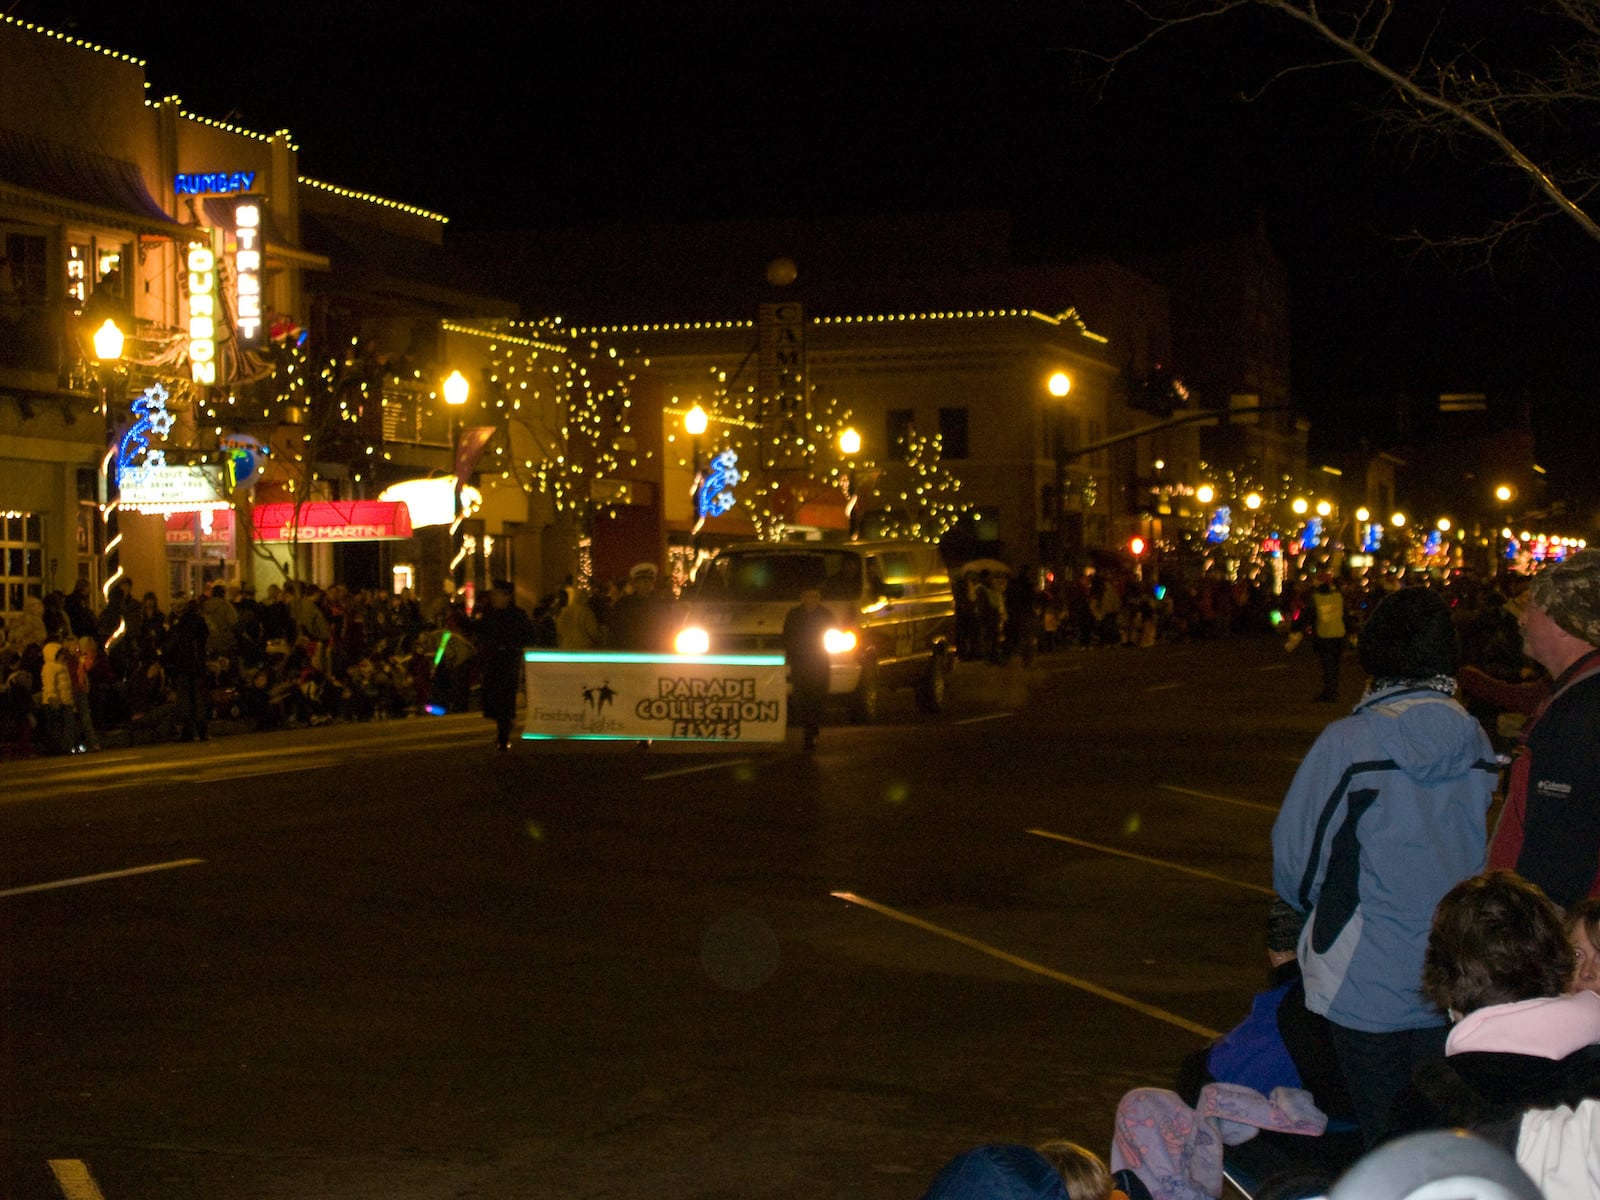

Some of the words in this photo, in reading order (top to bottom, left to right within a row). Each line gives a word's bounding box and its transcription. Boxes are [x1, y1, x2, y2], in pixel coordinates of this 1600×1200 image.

[174, 171, 255, 195] RUMBAY
[235, 205, 260, 339] STREET
[188, 242, 216, 384] OURBON
[318, 524, 386, 538] MARTINI
[658, 677, 757, 701] PARADE
[636, 698, 779, 722] COLLECTION
[672, 719, 741, 740] ELVES
